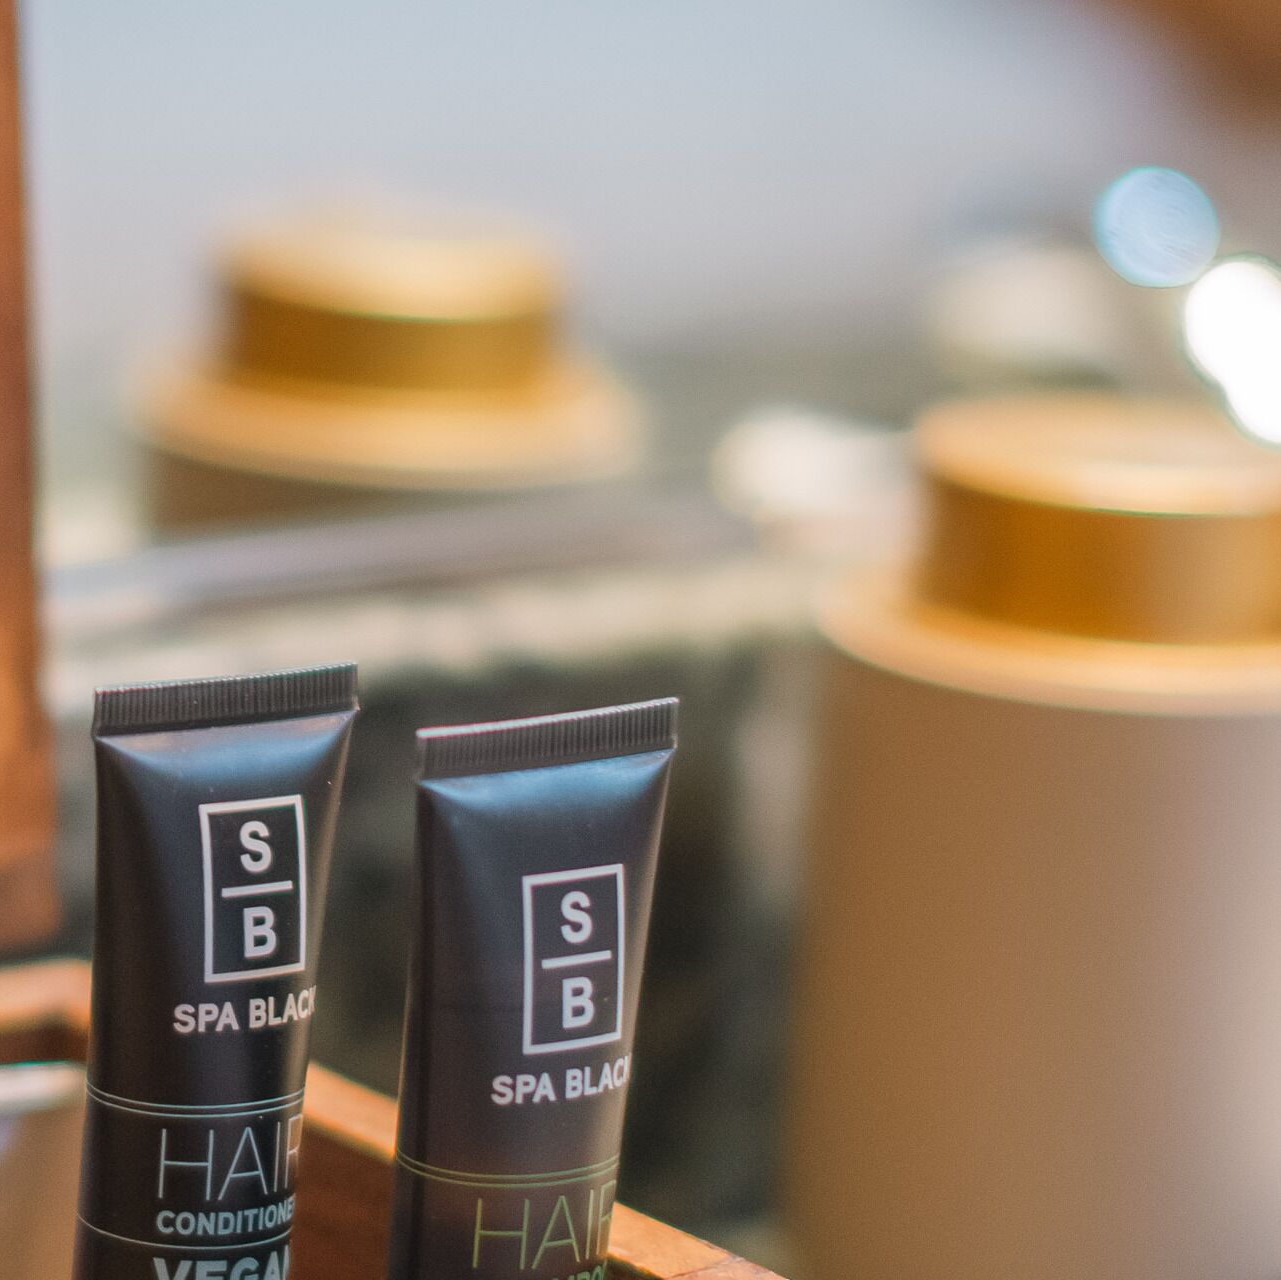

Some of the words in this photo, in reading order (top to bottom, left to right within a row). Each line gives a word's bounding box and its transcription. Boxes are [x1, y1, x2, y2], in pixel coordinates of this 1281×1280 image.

[240, 820, 270, 874] S
[243, 905, 277, 959] B
[559, 890, 593, 944] S
[173, 1001, 240, 1034] SPA
[248, 985, 317, 1029] BLACK
[562, 977, 595, 1030] B
[491, 1072, 557, 1105] SPA
[158, 1114, 304, 1200] HAIR
[156, 1193, 296, 1236] CONDITIONE
